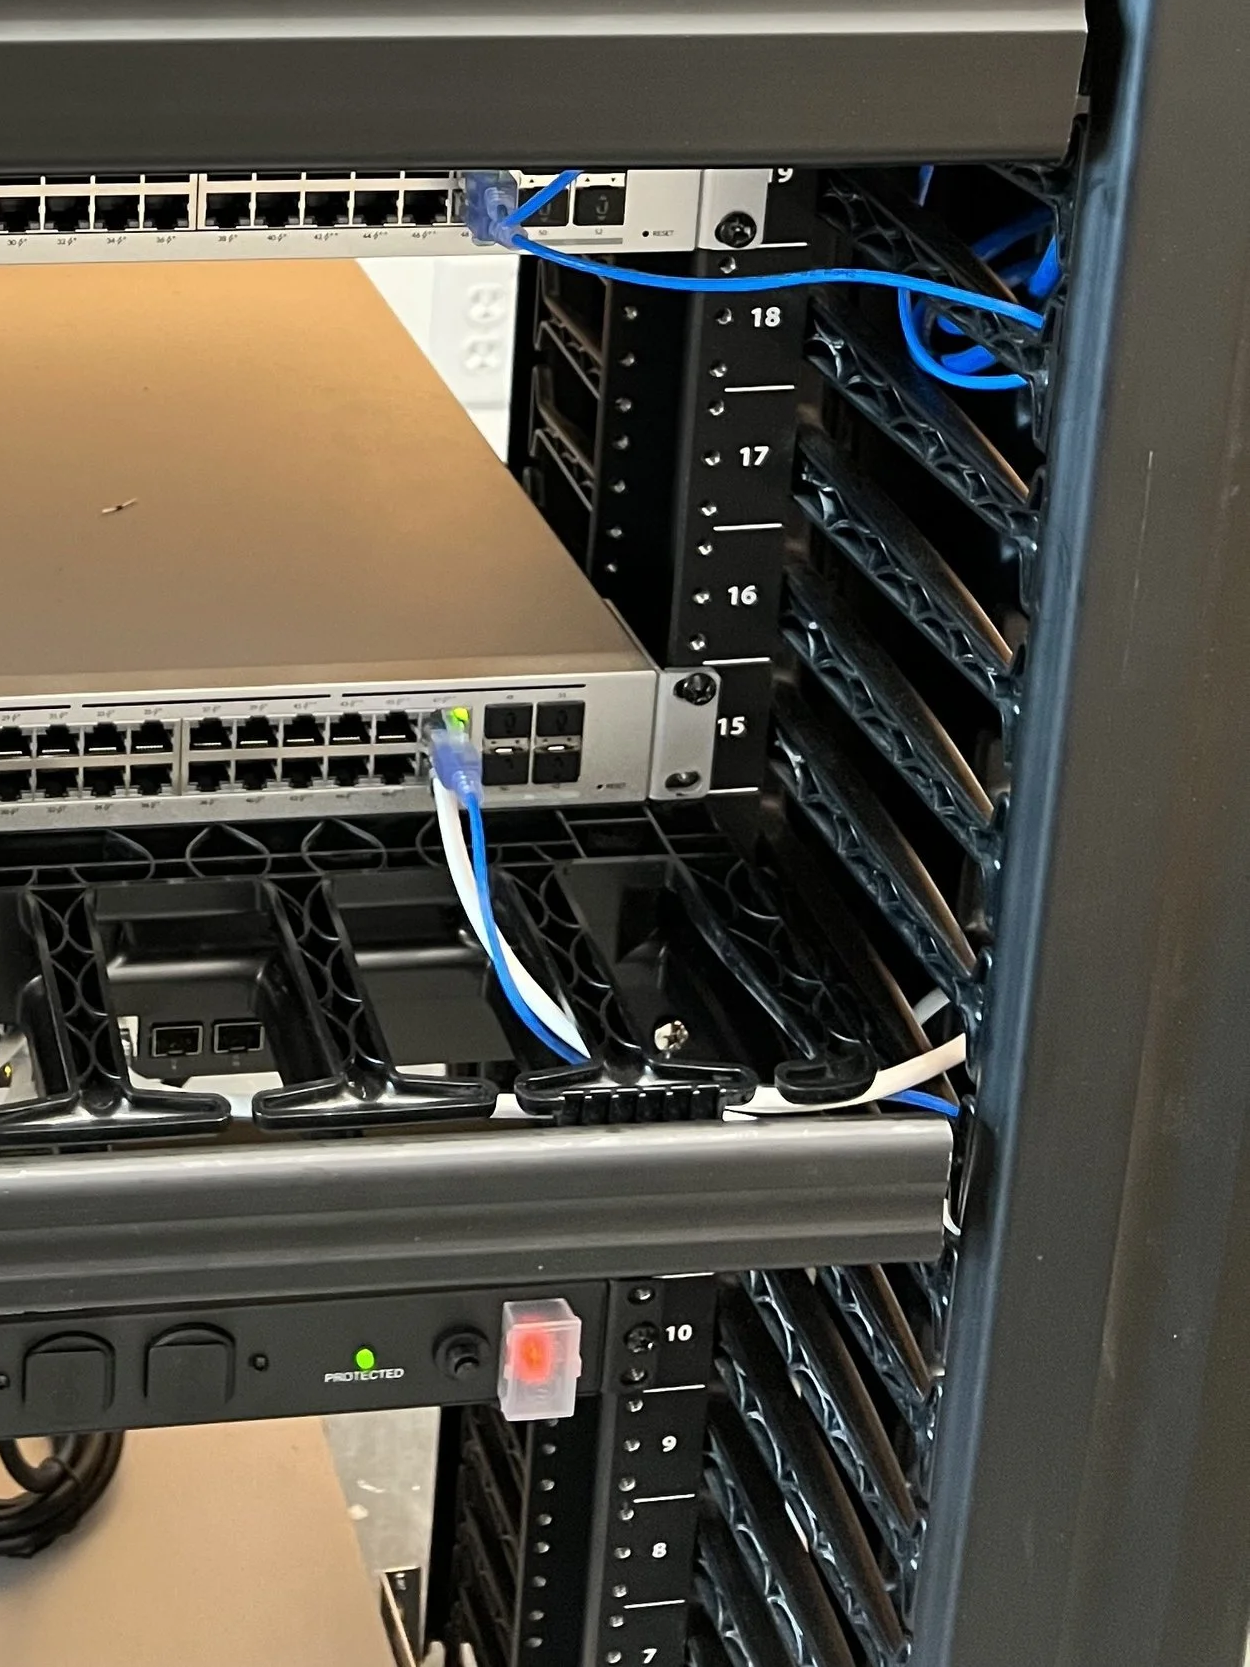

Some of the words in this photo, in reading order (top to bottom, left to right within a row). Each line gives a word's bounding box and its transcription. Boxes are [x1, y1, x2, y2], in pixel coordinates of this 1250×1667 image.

[751, 306, 780, 328] 18
[739, 445, 769, 467] 17
[727, 585, 758, 606] 16
[717, 716, 745, 736] 15
[665, 1324, 692, 1342] 10
[324, 1366, 405, 1383] PROTECTED
[661, 1435, 677, 1453] 9
[652, 1542, 667, 1559] 8
[643, 1648, 658, 1664] 7
